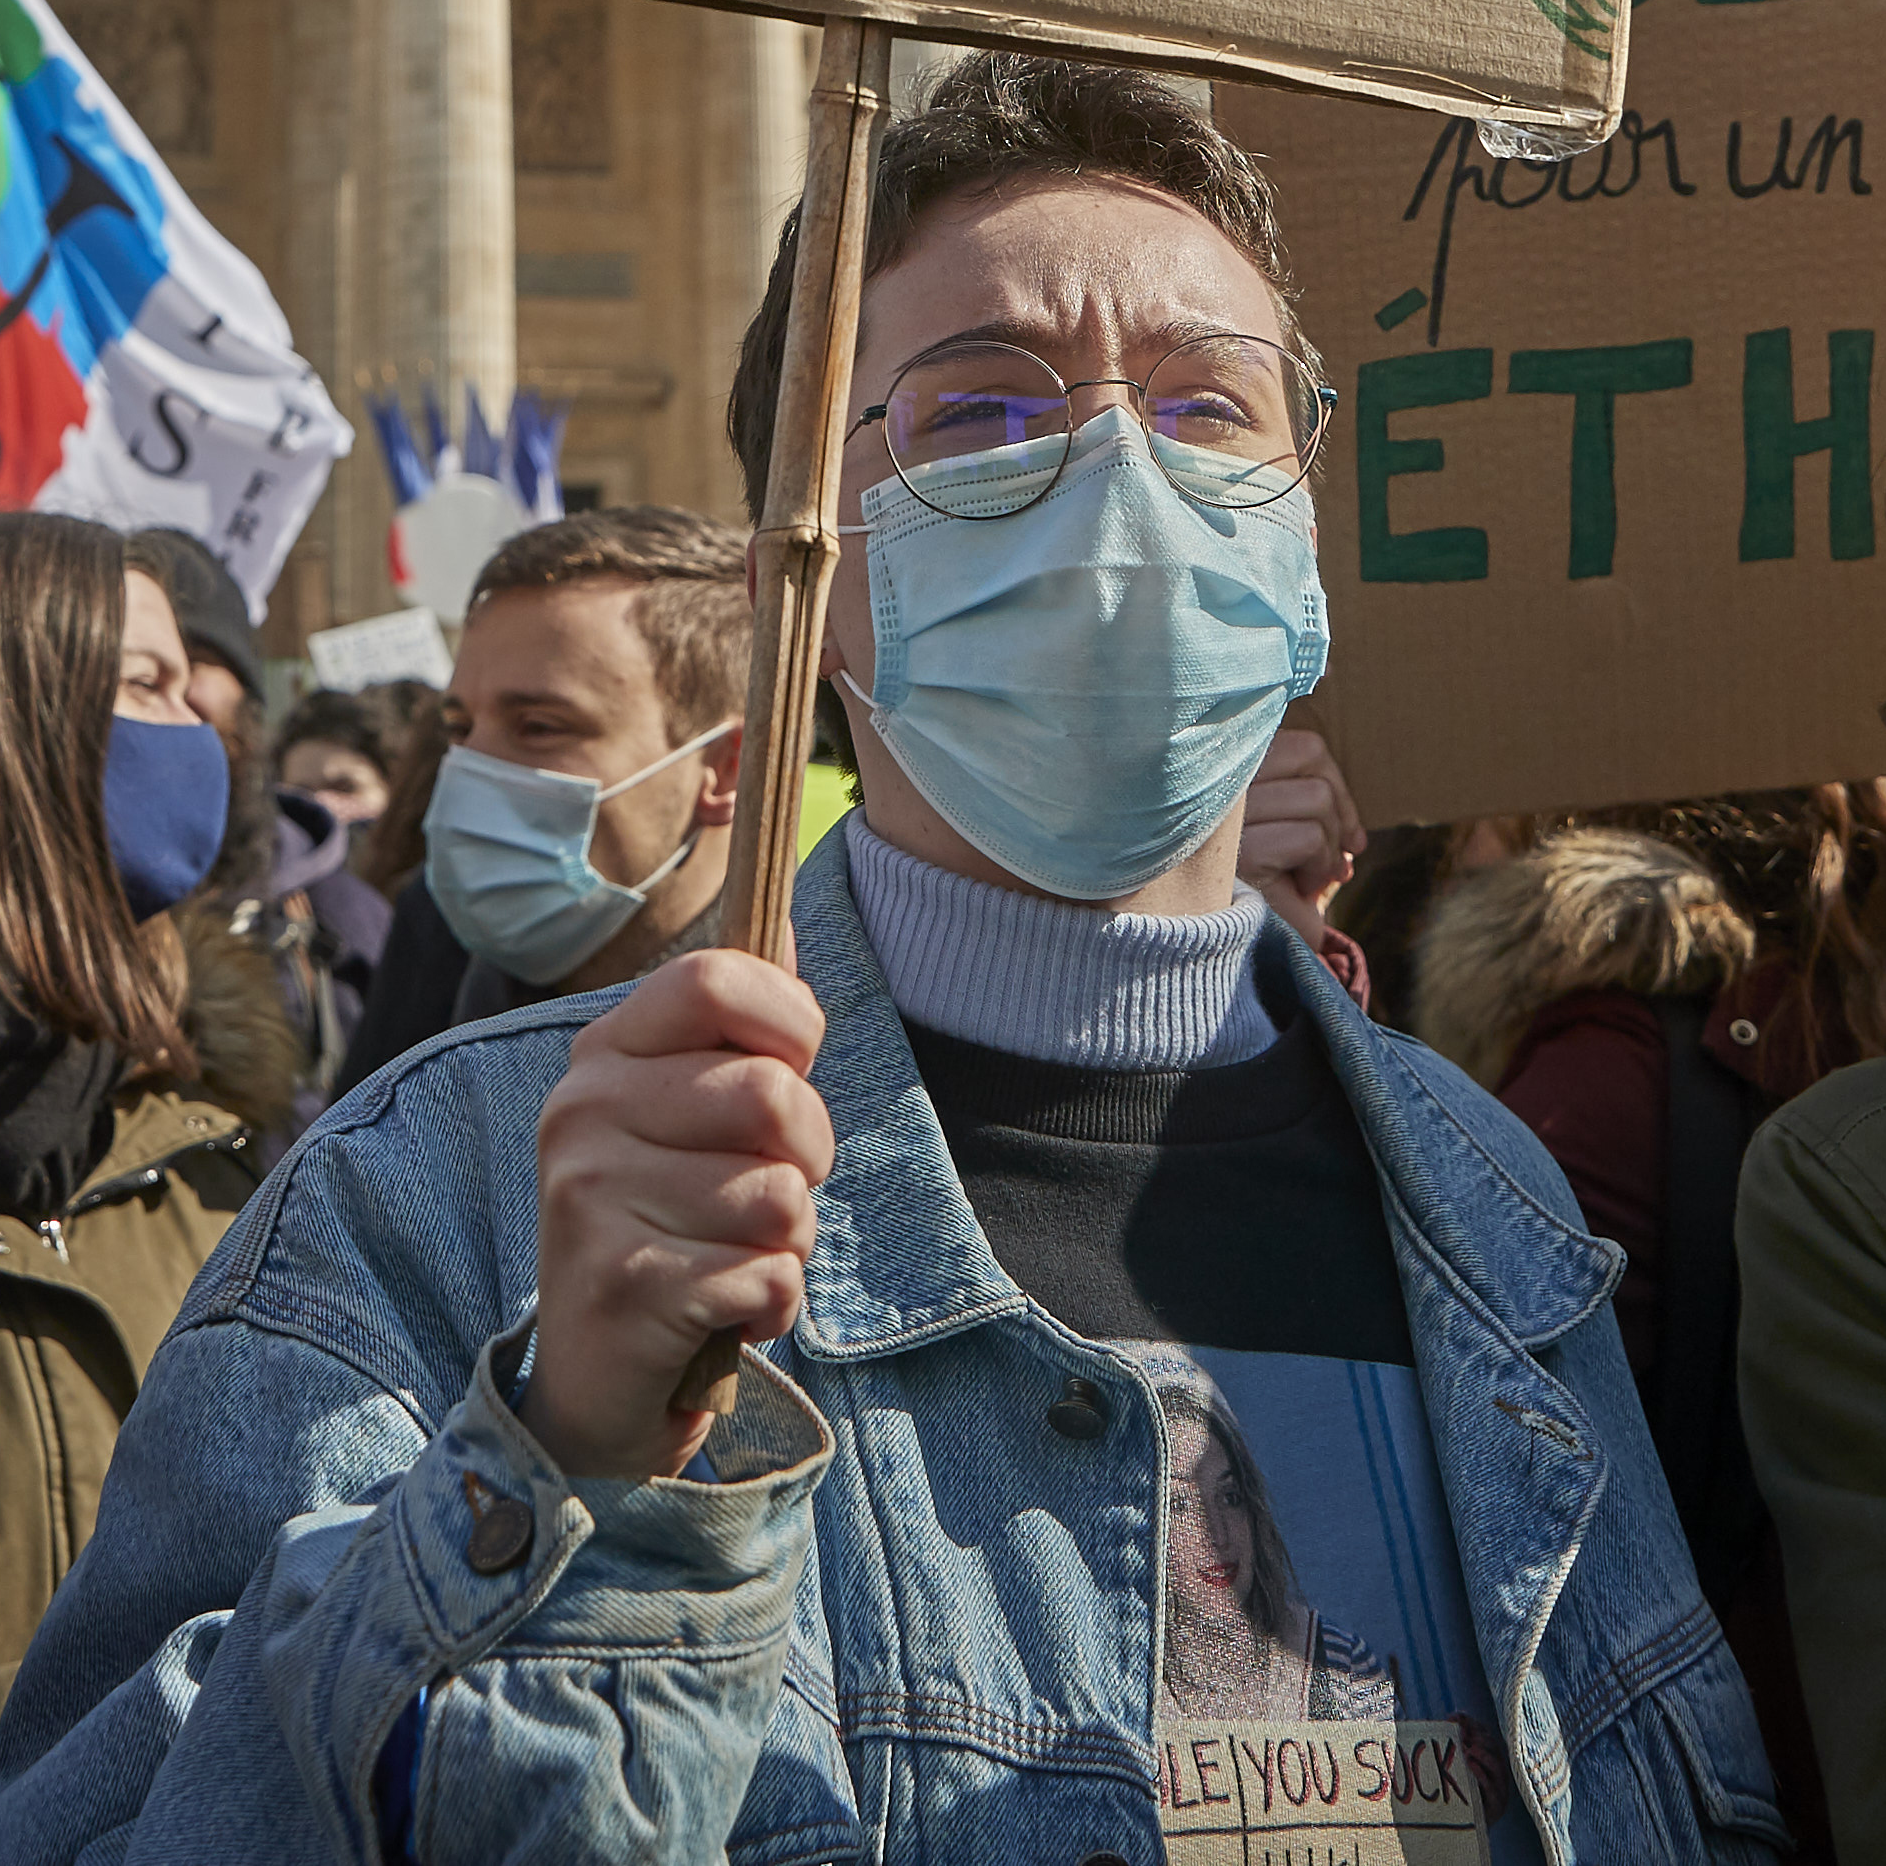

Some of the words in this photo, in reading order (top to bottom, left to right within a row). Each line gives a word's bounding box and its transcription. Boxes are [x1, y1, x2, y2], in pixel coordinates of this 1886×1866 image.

[1725, 112, 1873, 200] un
[1240, 1737, 1341, 1814] YOU
[1353, 1737, 1470, 1807] SUCK
